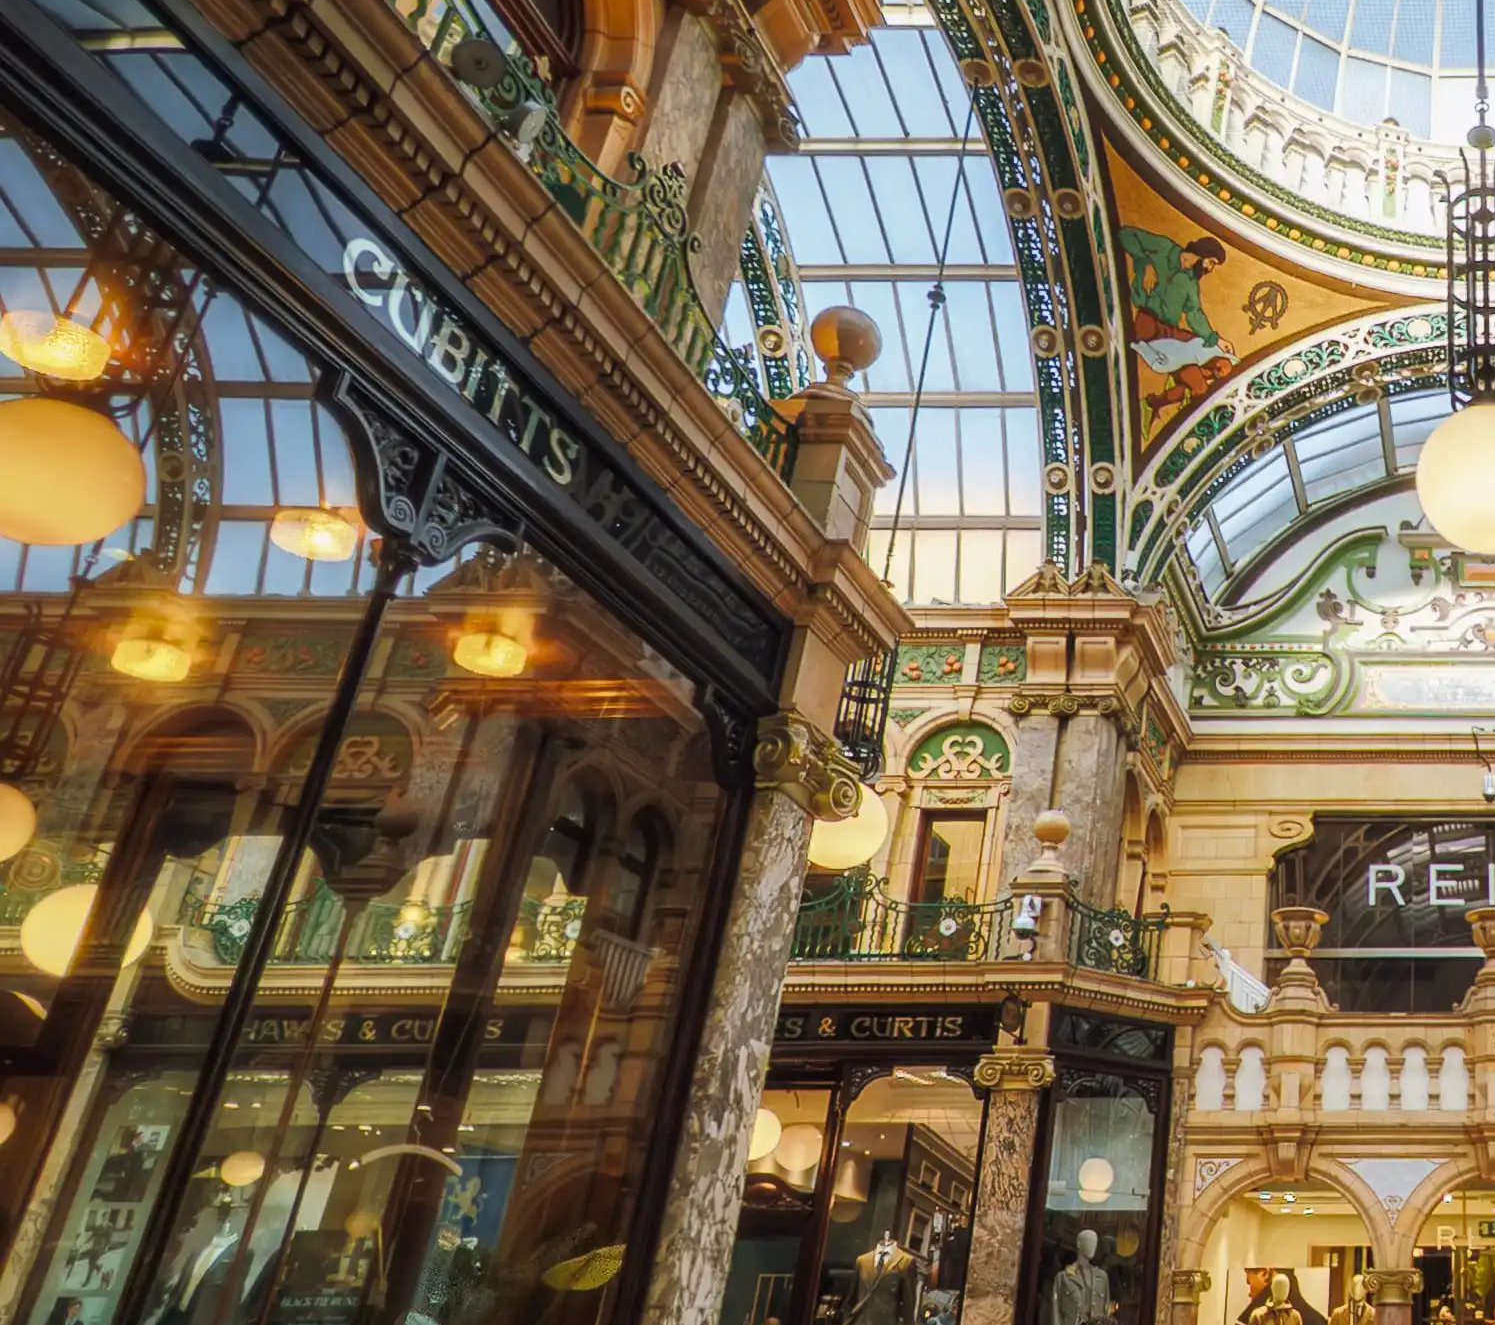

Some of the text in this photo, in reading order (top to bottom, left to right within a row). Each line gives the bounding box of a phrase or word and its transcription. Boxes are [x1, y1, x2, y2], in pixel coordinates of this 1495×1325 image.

[342, 237, 581, 486] CUBITTS
[358, 1019, 377, 1040] &
[391, 1018, 504, 1041] CUS
[818, 1016, 836, 1037] &
[850, 1016, 964, 1038] CURTIS
